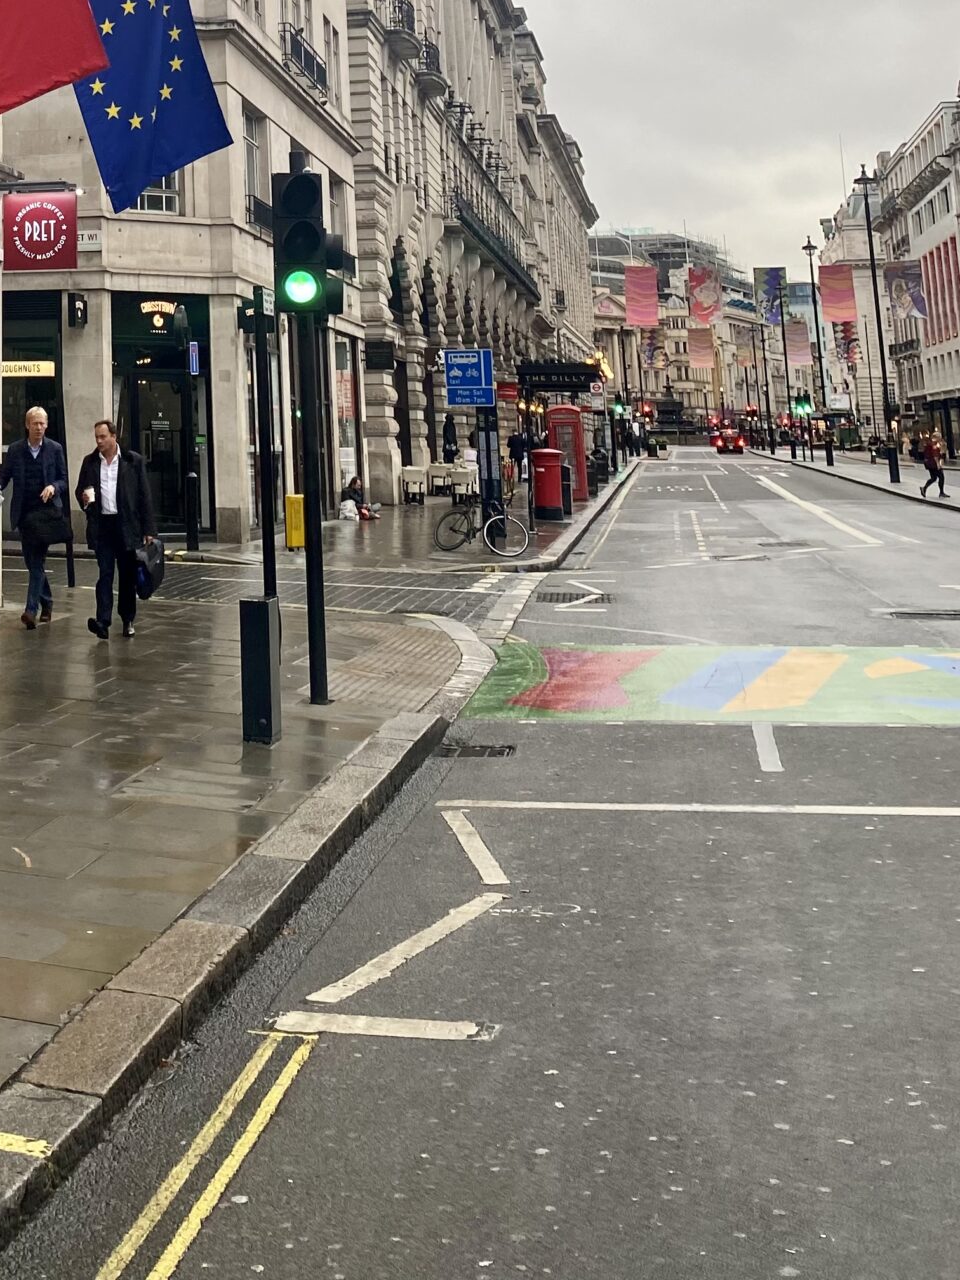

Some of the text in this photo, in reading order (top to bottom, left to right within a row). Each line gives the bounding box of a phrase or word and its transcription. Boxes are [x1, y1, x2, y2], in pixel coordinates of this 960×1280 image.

[15, 201, 65, 222] ORGANIC COFFEE
[24, 220, 56, 241] PRET
[87, 233, 98, 241] W1
[13, 235, 67, 260] FRESHLY MADE FOOD
